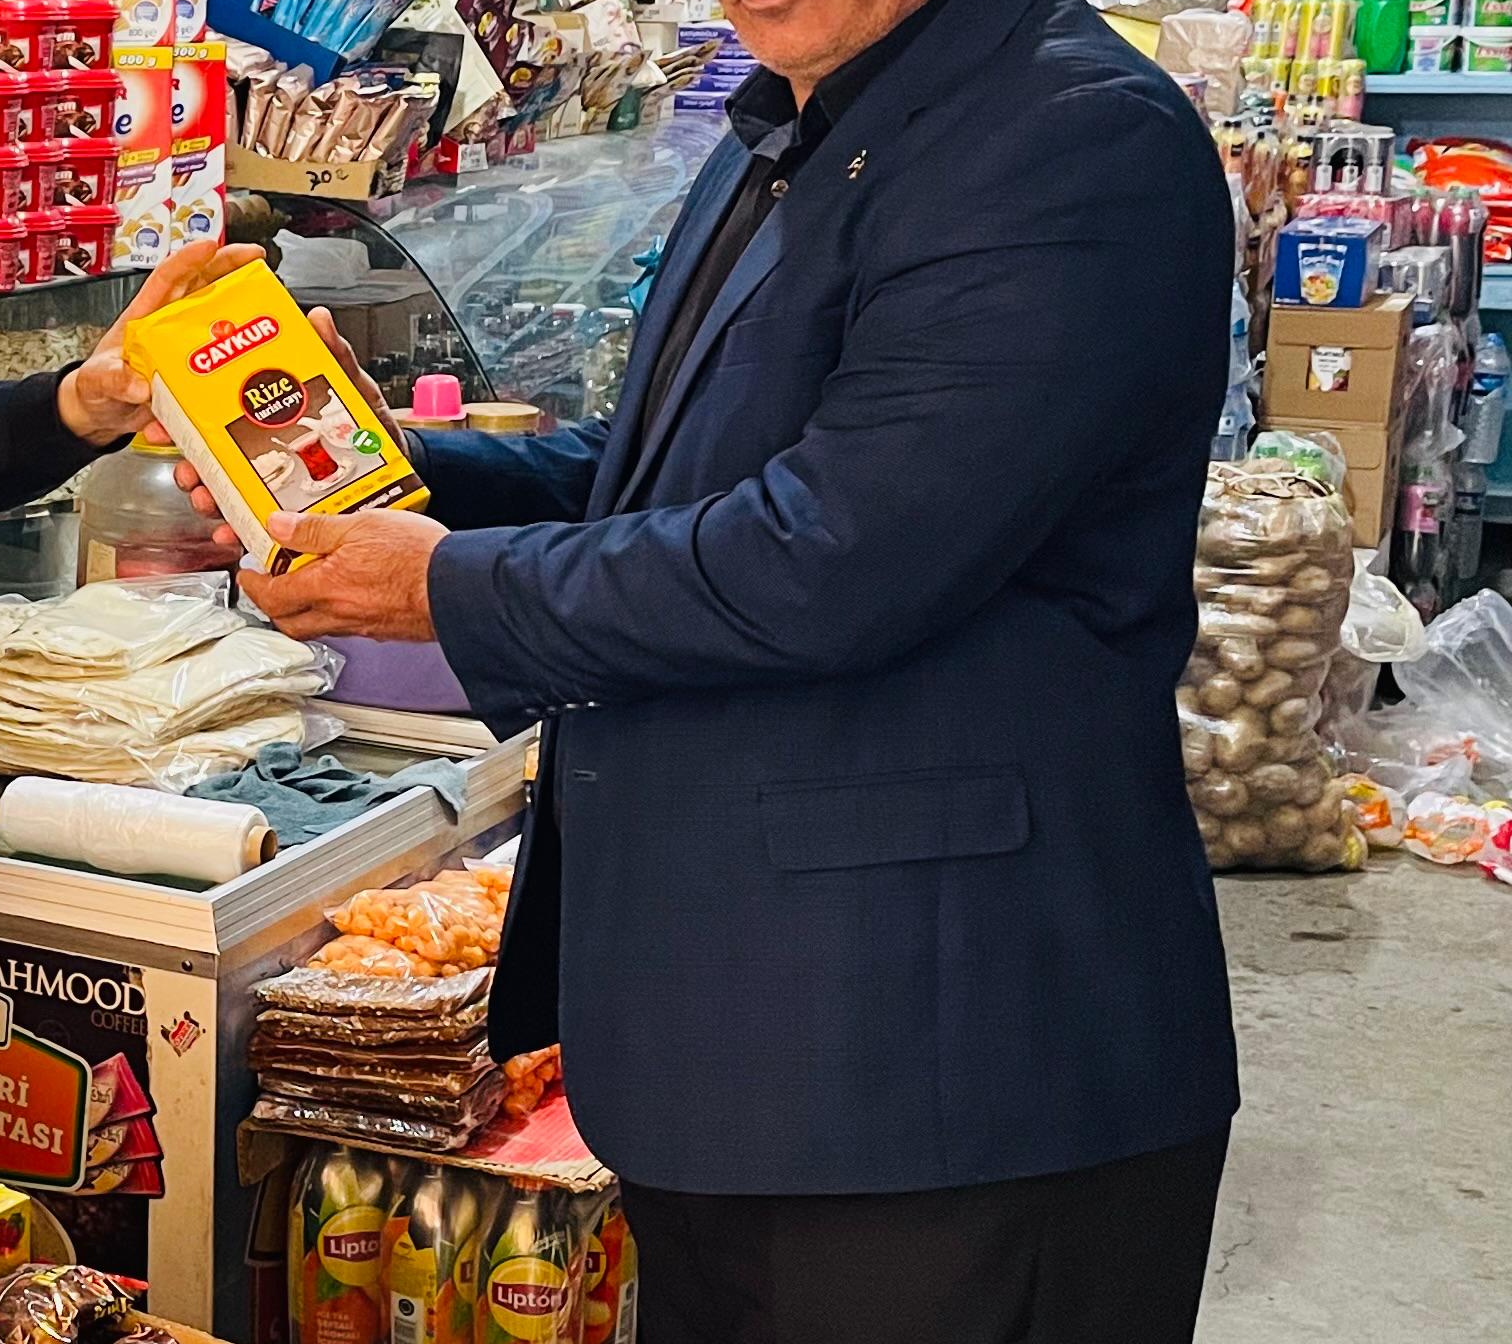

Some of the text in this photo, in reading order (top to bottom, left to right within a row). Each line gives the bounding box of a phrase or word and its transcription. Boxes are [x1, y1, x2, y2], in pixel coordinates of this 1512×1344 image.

[193, 318, 277, 373] ÇAYKUR
[244, 376, 293, 410] Rize
[89, 1009, 148, 1037] COFFEE
